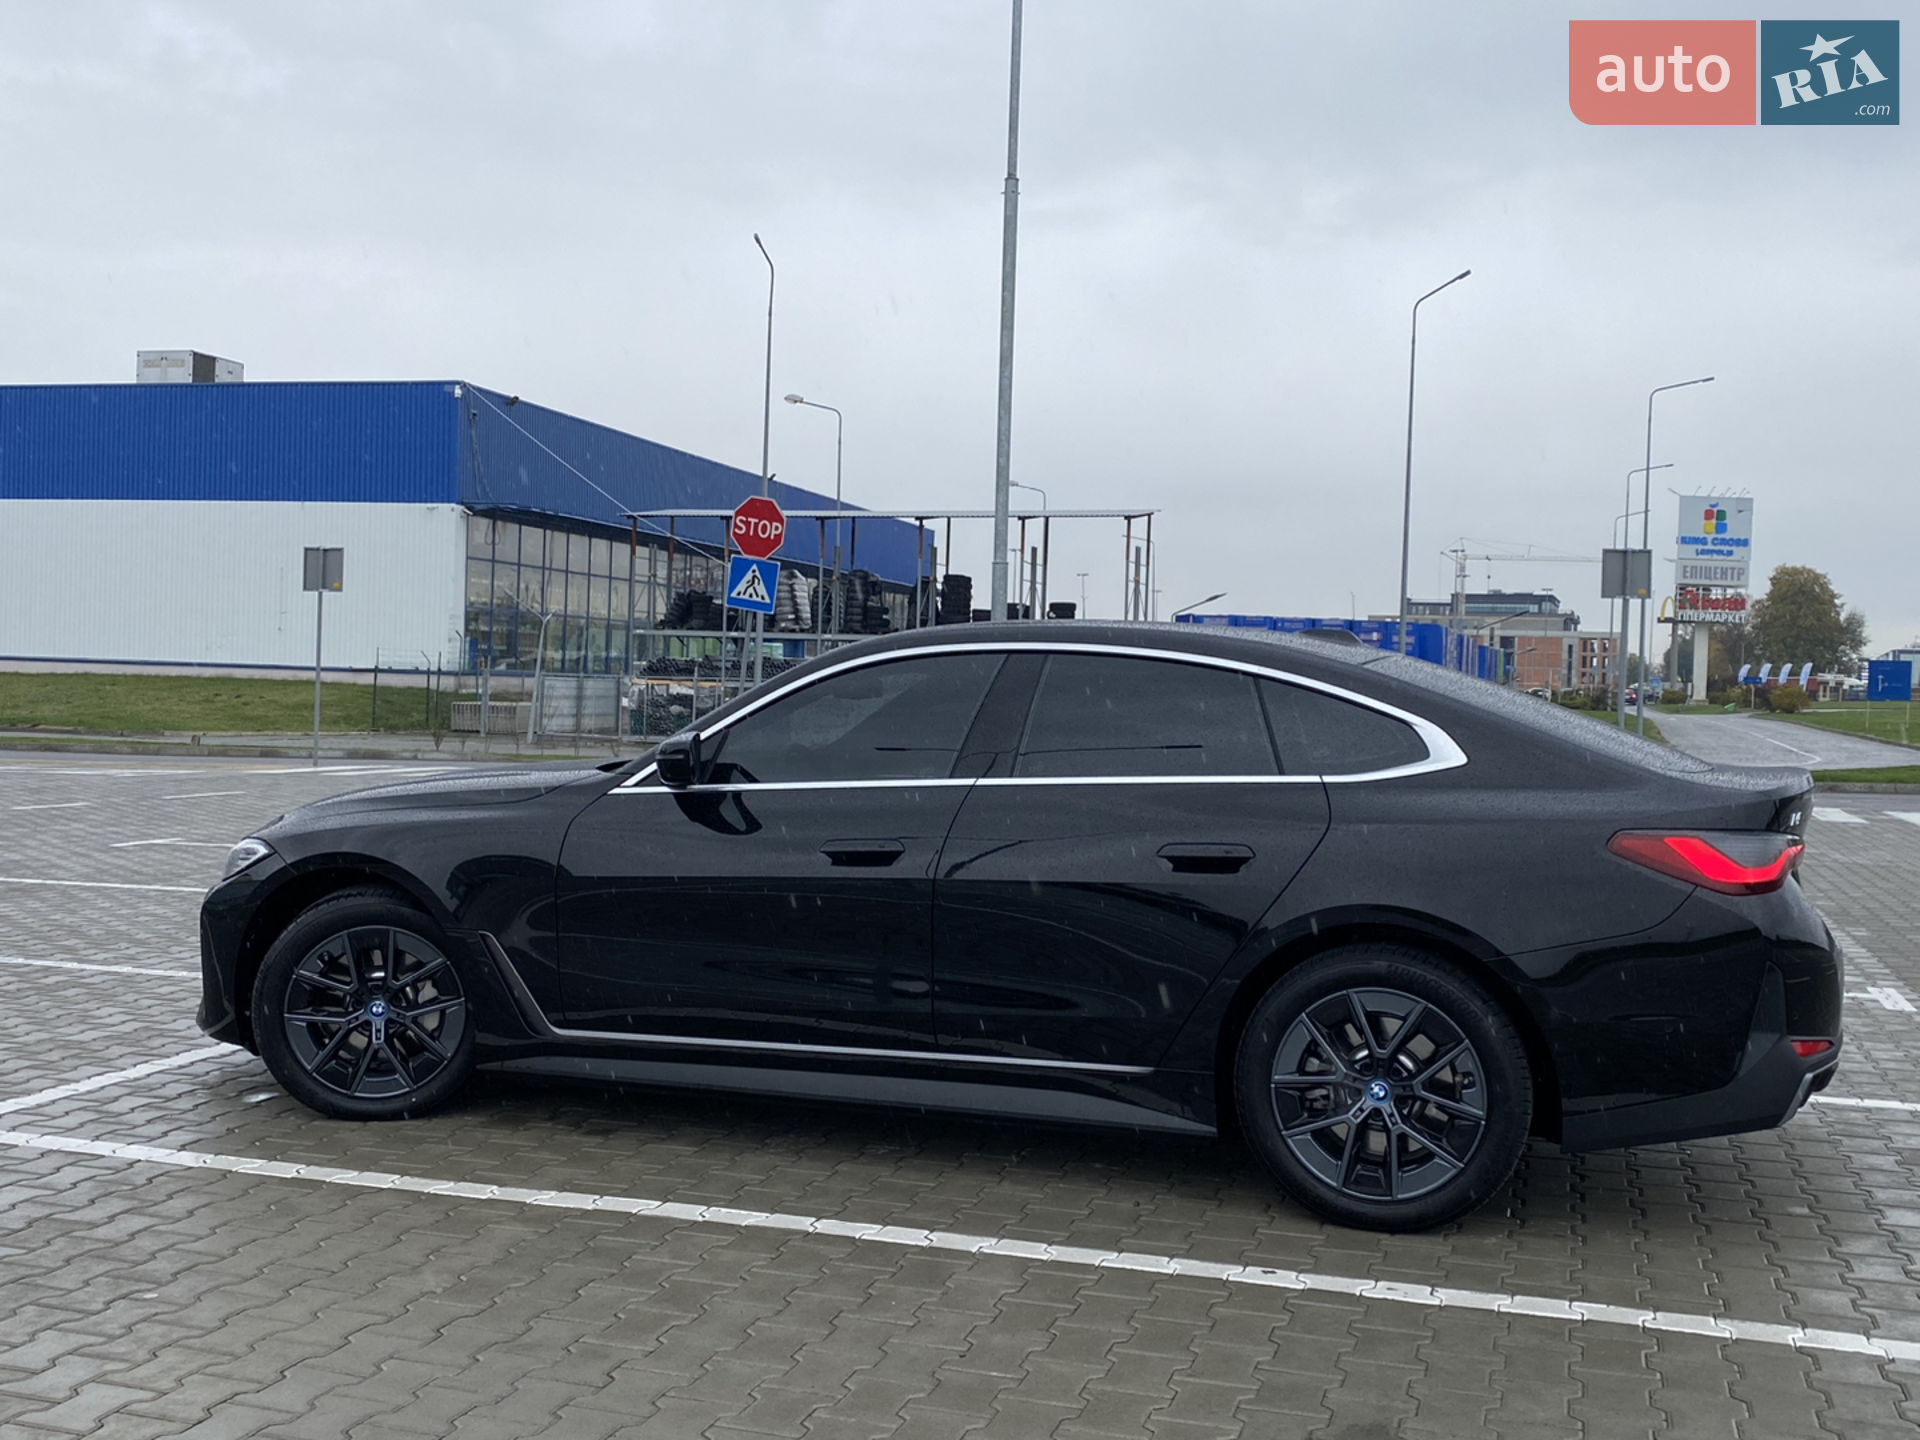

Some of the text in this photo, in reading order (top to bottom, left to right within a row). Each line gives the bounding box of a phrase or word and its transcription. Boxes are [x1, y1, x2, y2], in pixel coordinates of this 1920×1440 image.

[734, 515, 782, 540] STOP
[1680, 536, 1749, 547] KING CROSS
[1682, 565, 1745, 581] ЕПІЦЕНТР
[1678, 612, 1746, 623] ГІПЕРМАРКЕТ
